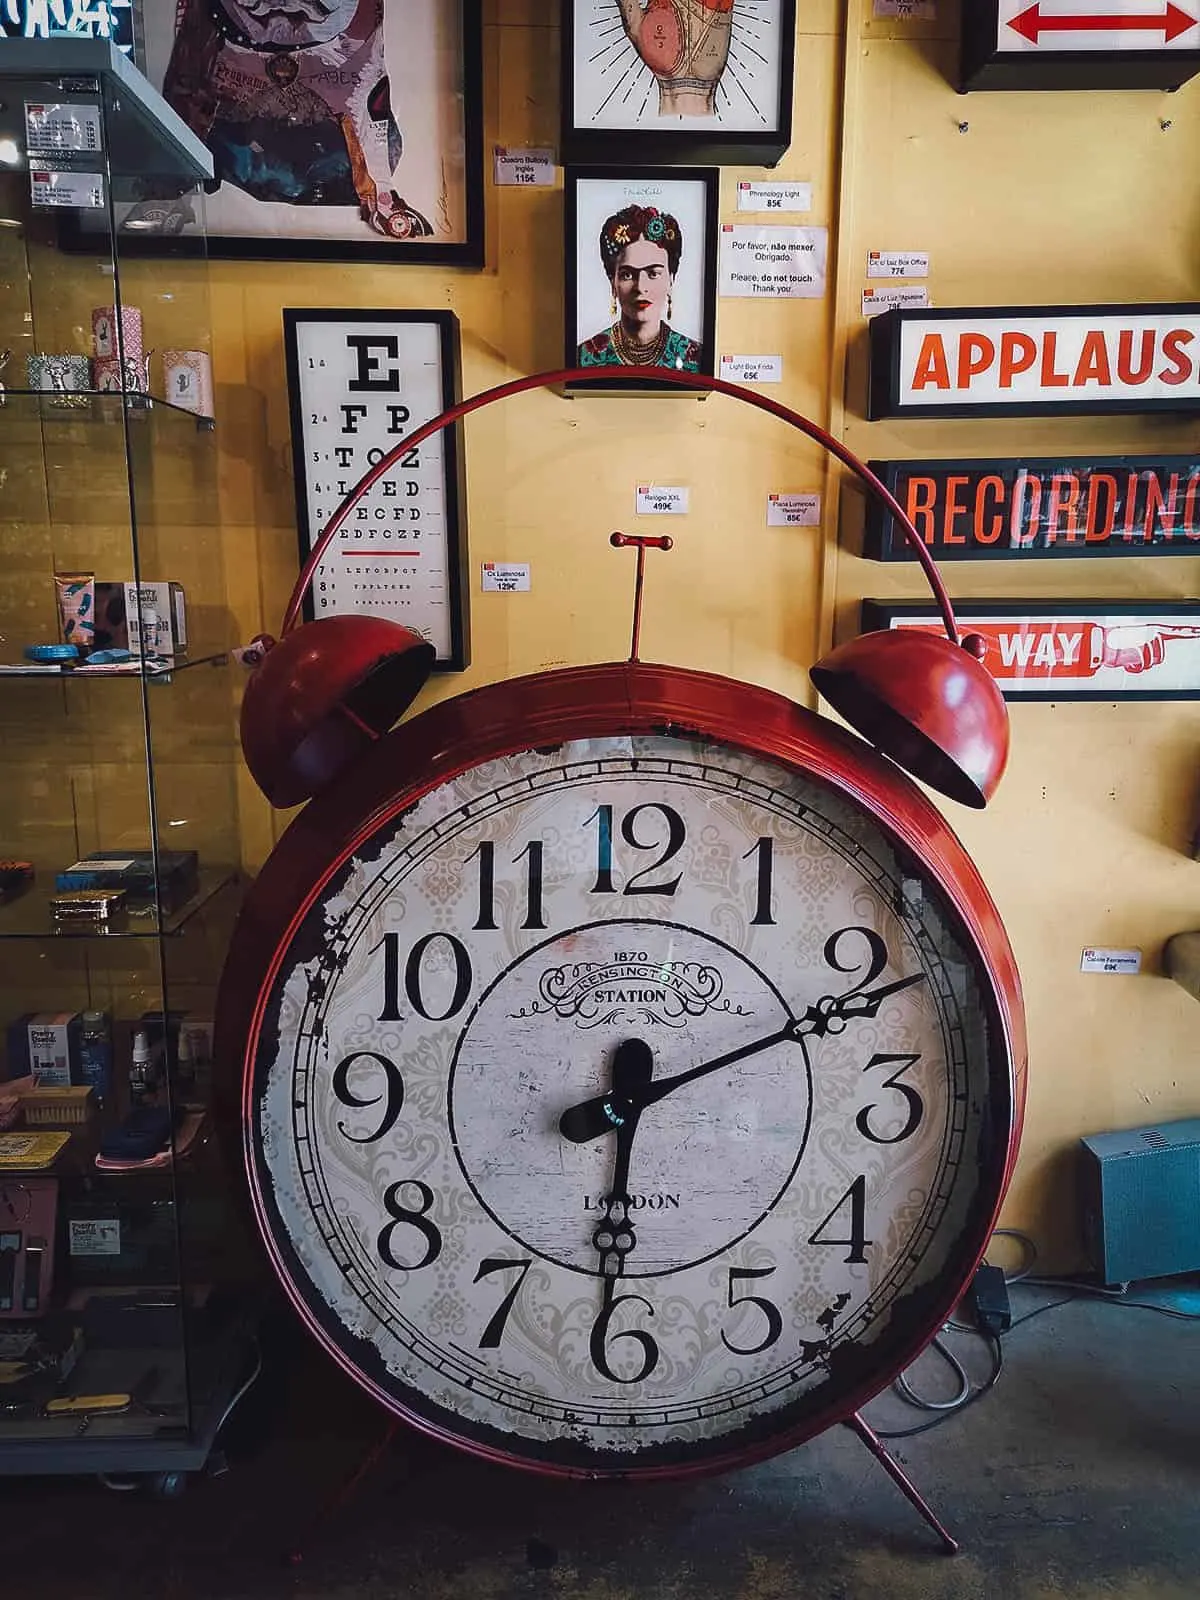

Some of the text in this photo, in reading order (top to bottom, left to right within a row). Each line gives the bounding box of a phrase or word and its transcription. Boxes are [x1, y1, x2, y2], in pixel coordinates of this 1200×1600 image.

[515, 174, 537, 182] 115€
[749, 190, 800, 199] Phrenology Light
[766, 199, 782, 208] 85€
[732, 241, 745, 250] Por
[747, 241, 769, 251] favor,
[771, 242, 787, 251] não
[755, 253, 793, 263] Obrigado.
[891, 267, 905, 275] 77€
[761, 274, 772, 282] do
[774, 274, 787, 282] not
[752, 284, 775, 293] Thank
[308, 335, 400, 392] 1 E
[911, 329, 1200, 390] APPLAUS
[743, 372, 759, 380] 65€
[311, 414, 318, 424] 2
[313, 452, 320, 462] 3
[315, 483, 322, 493] 4
[653, 502, 673, 510] 499€
[316, 509, 323, 518] 5
[786, 514, 801, 522] 85€
[319, 566, 325, 576] 7
[319, 582, 327, 592] 8
[497, 582, 517, 590] 129€
[320, 598, 328, 608] 9
[998, 633, 1083, 667] WAY
[582, 802, 686, 896] 12
[463, 840, 548, 930] 11
[742, 836, 778, 925] 1
[613, 951, 648, 962] 1870
[368, 931, 473, 1021] 10
[823, 926, 889, 1018] 2
[578, 966, 684, 991] KENSINGTON
[594, 989, 667, 1002] STATION
[332, 1051, 404, 1143] 9
[855, 1053, 923, 1144] 3
[583, 1193, 681, 1210] LODON
[808, 1174, 873, 1264] 4
[377, 1180, 442, 1271] 8
[473, 1259, 533, 1348] 7
[720, 1266, 783, 1355] 5
[589, 1294, 659, 1384] 6
